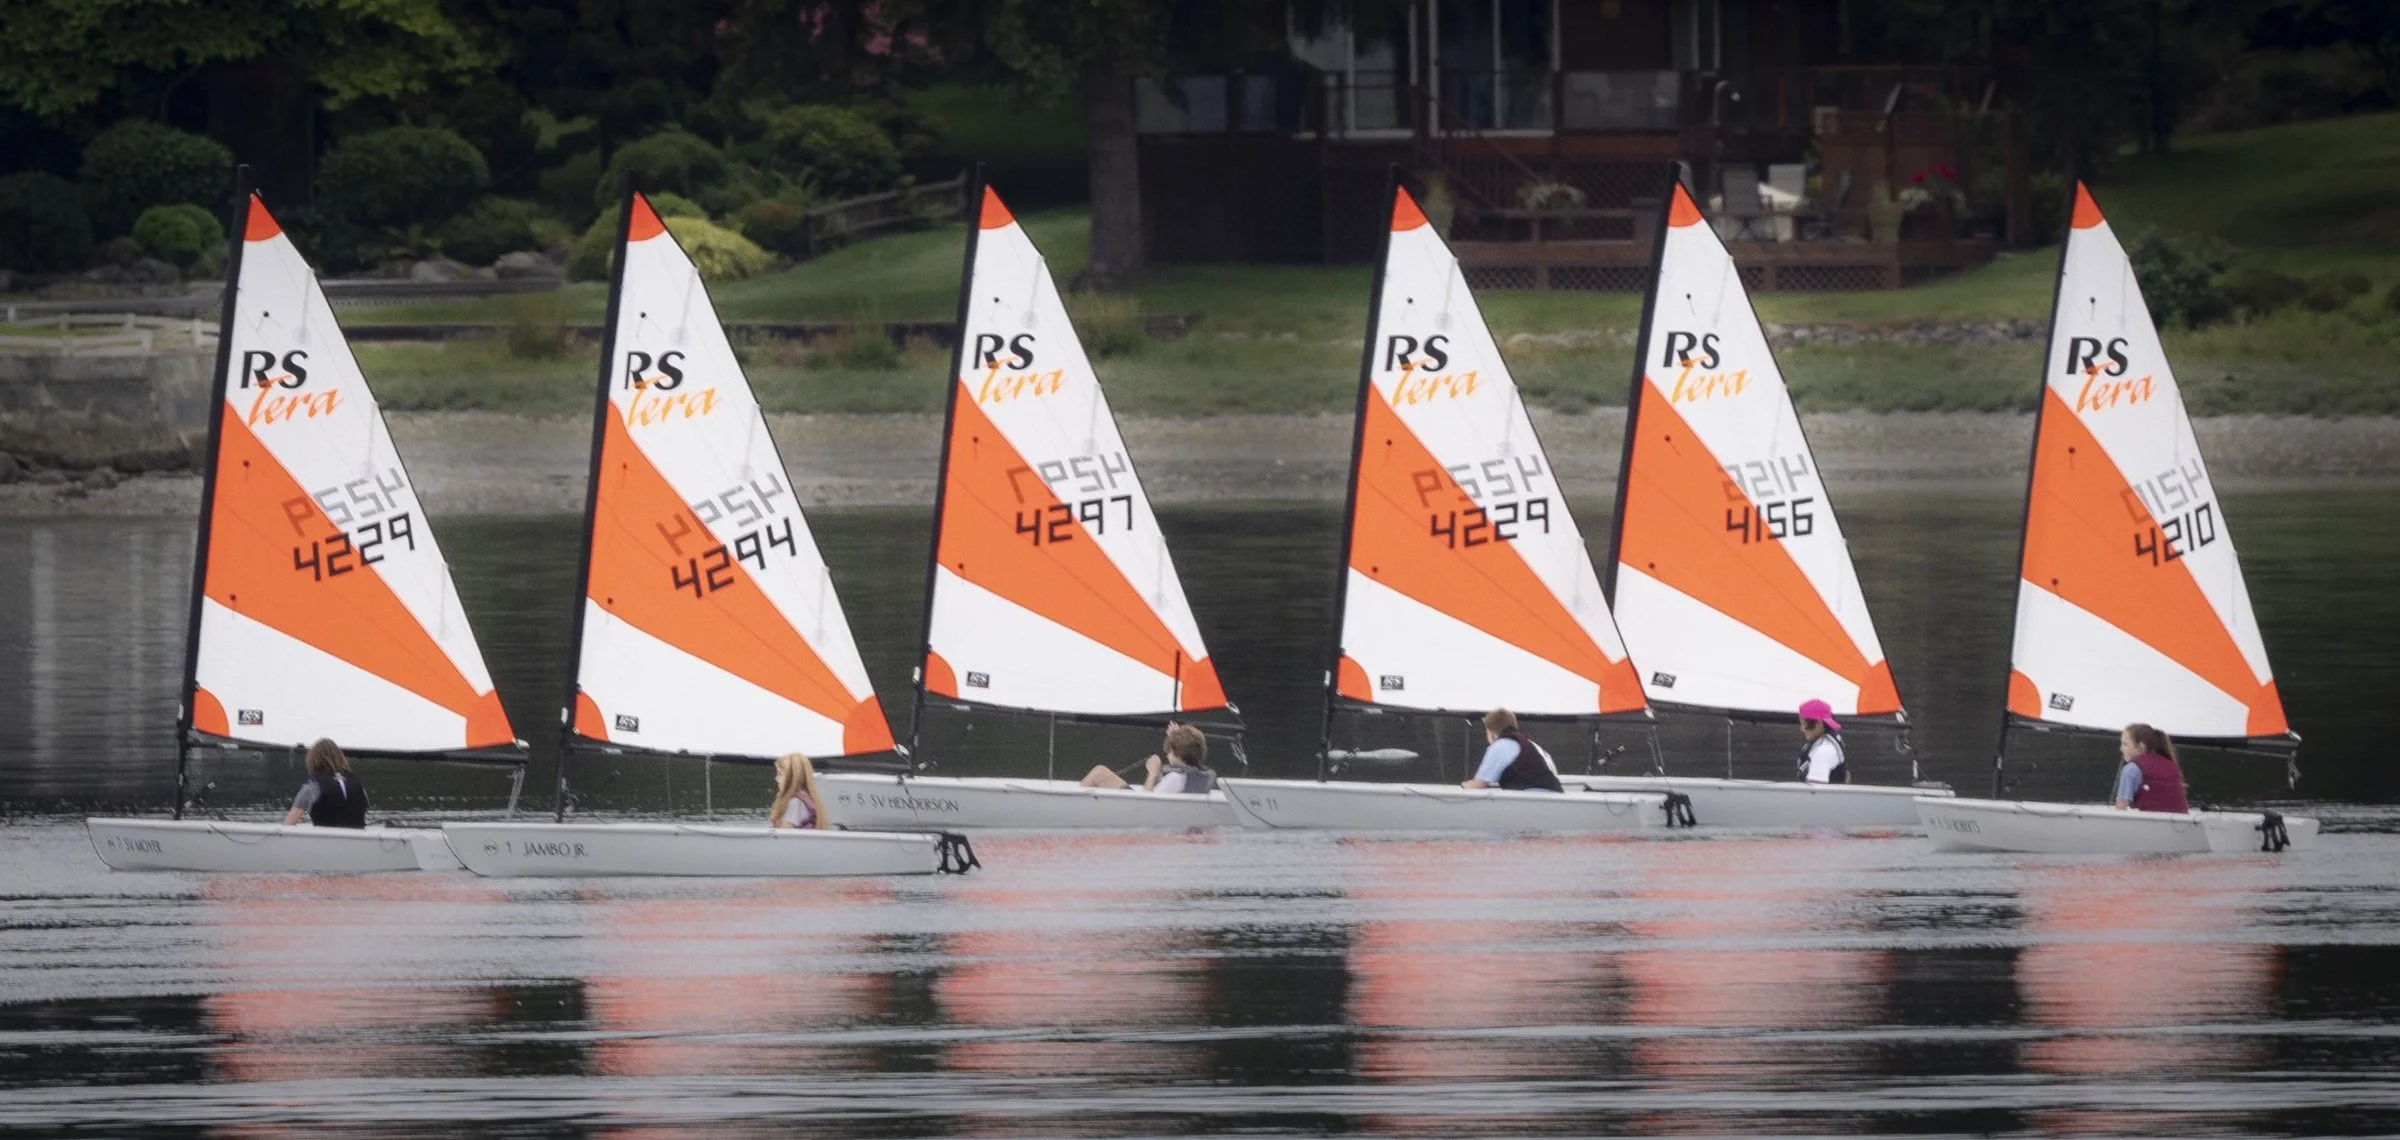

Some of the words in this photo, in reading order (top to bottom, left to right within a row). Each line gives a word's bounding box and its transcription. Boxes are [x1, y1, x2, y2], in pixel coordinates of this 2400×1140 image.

[240, 350, 309, 389] RS
[623, 351, 686, 390] RS
[973, 333, 1036, 370] RS
[1384, 334, 1449, 372] RS
[1663, 331, 1720, 370] RS
[2065, 336, 2130, 377] RS
[248, 374, 342, 427] Tera
[626, 374, 722, 428] Tera
[979, 355, 1068, 405] Tera
[1391, 357, 1483, 407] Tera
[1672, 354, 1751, 406] Tera
[2076, 361, 2157, 413] Tera
[1016, 495, 1133, 547] 4297
[1430, 497, 1550, 551] 4229
[1725, 497, 1815, 545] 4156
[2134, 502, 2217, 567] 4210
[292, 512, 416, 582] 4229
[671, 517, 797, 599] 4294
[888, 795, 960, 812] HENDERSON
[523, 841, 570, 858] JAMBO
